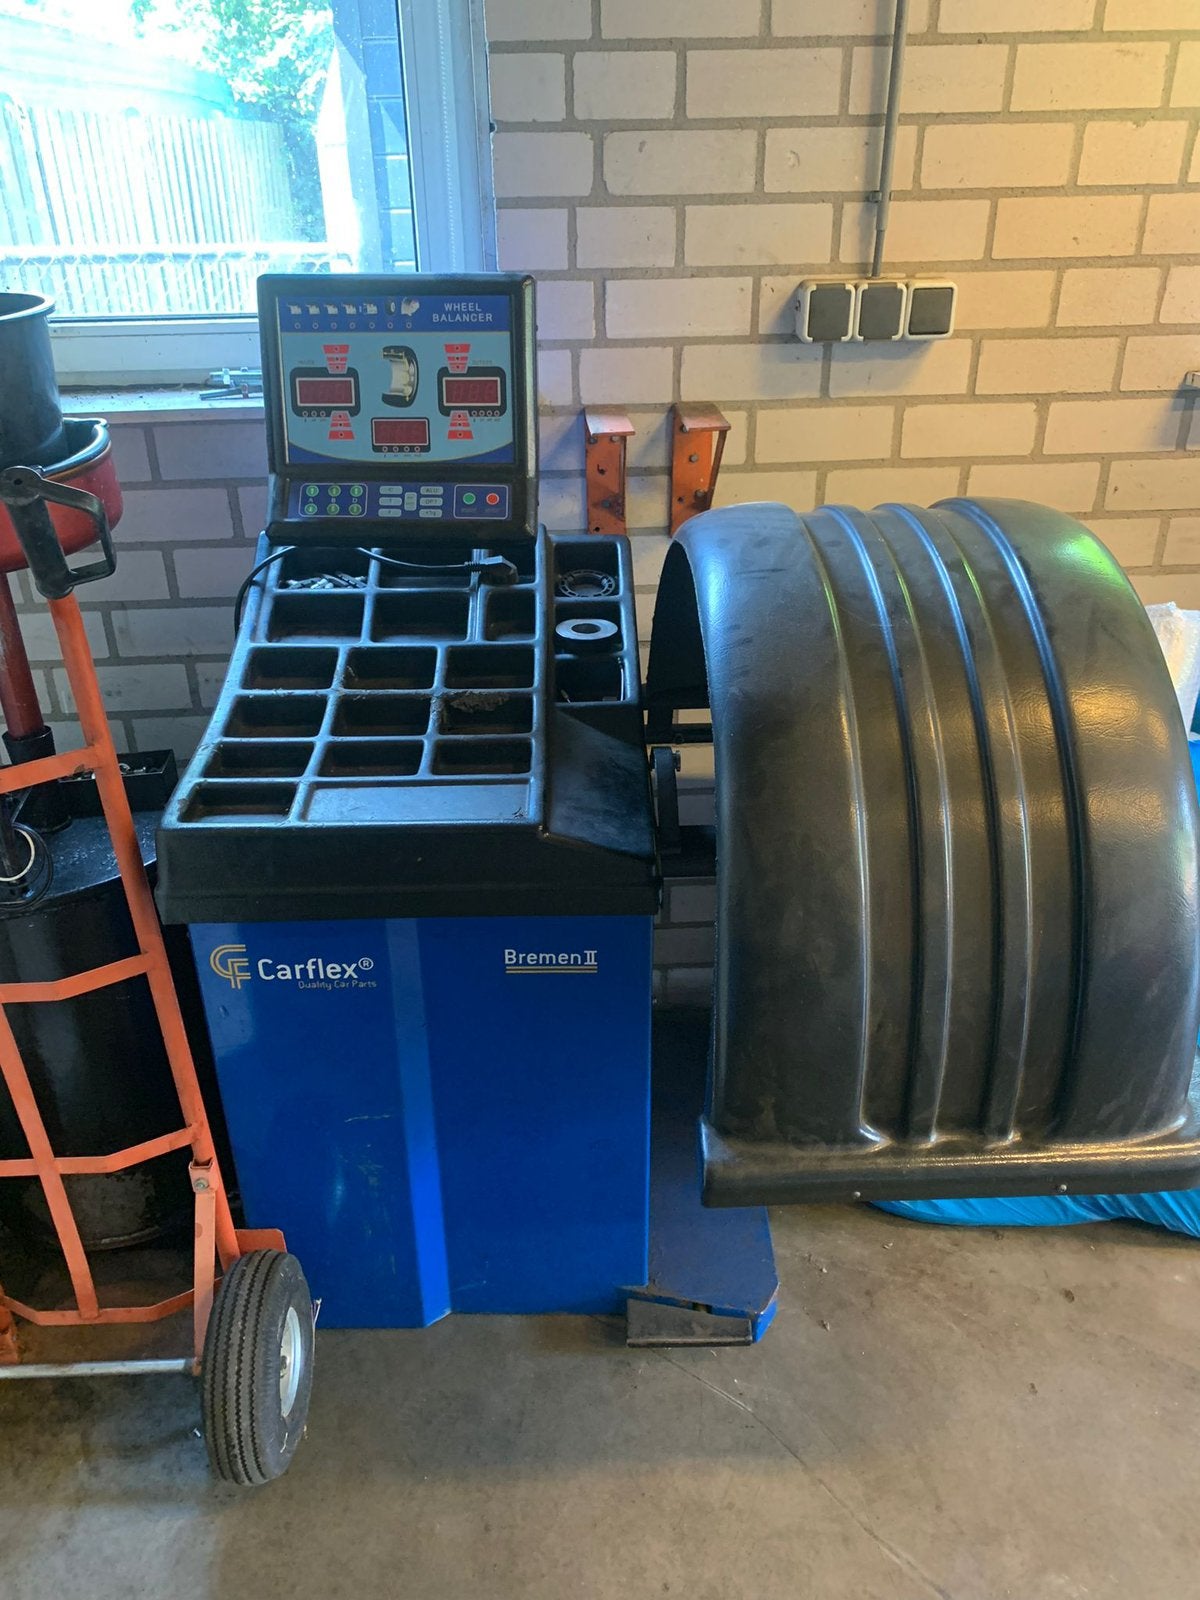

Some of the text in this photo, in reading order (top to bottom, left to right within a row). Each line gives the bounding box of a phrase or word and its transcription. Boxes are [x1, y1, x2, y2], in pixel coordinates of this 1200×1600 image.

[444, 302, 482, 312] WHEEL
[432, 313, 493, 323] BALANCER
[504, 949, 581, 965] Bremen
[298, 979, 377, 991] Quality Car Parts
